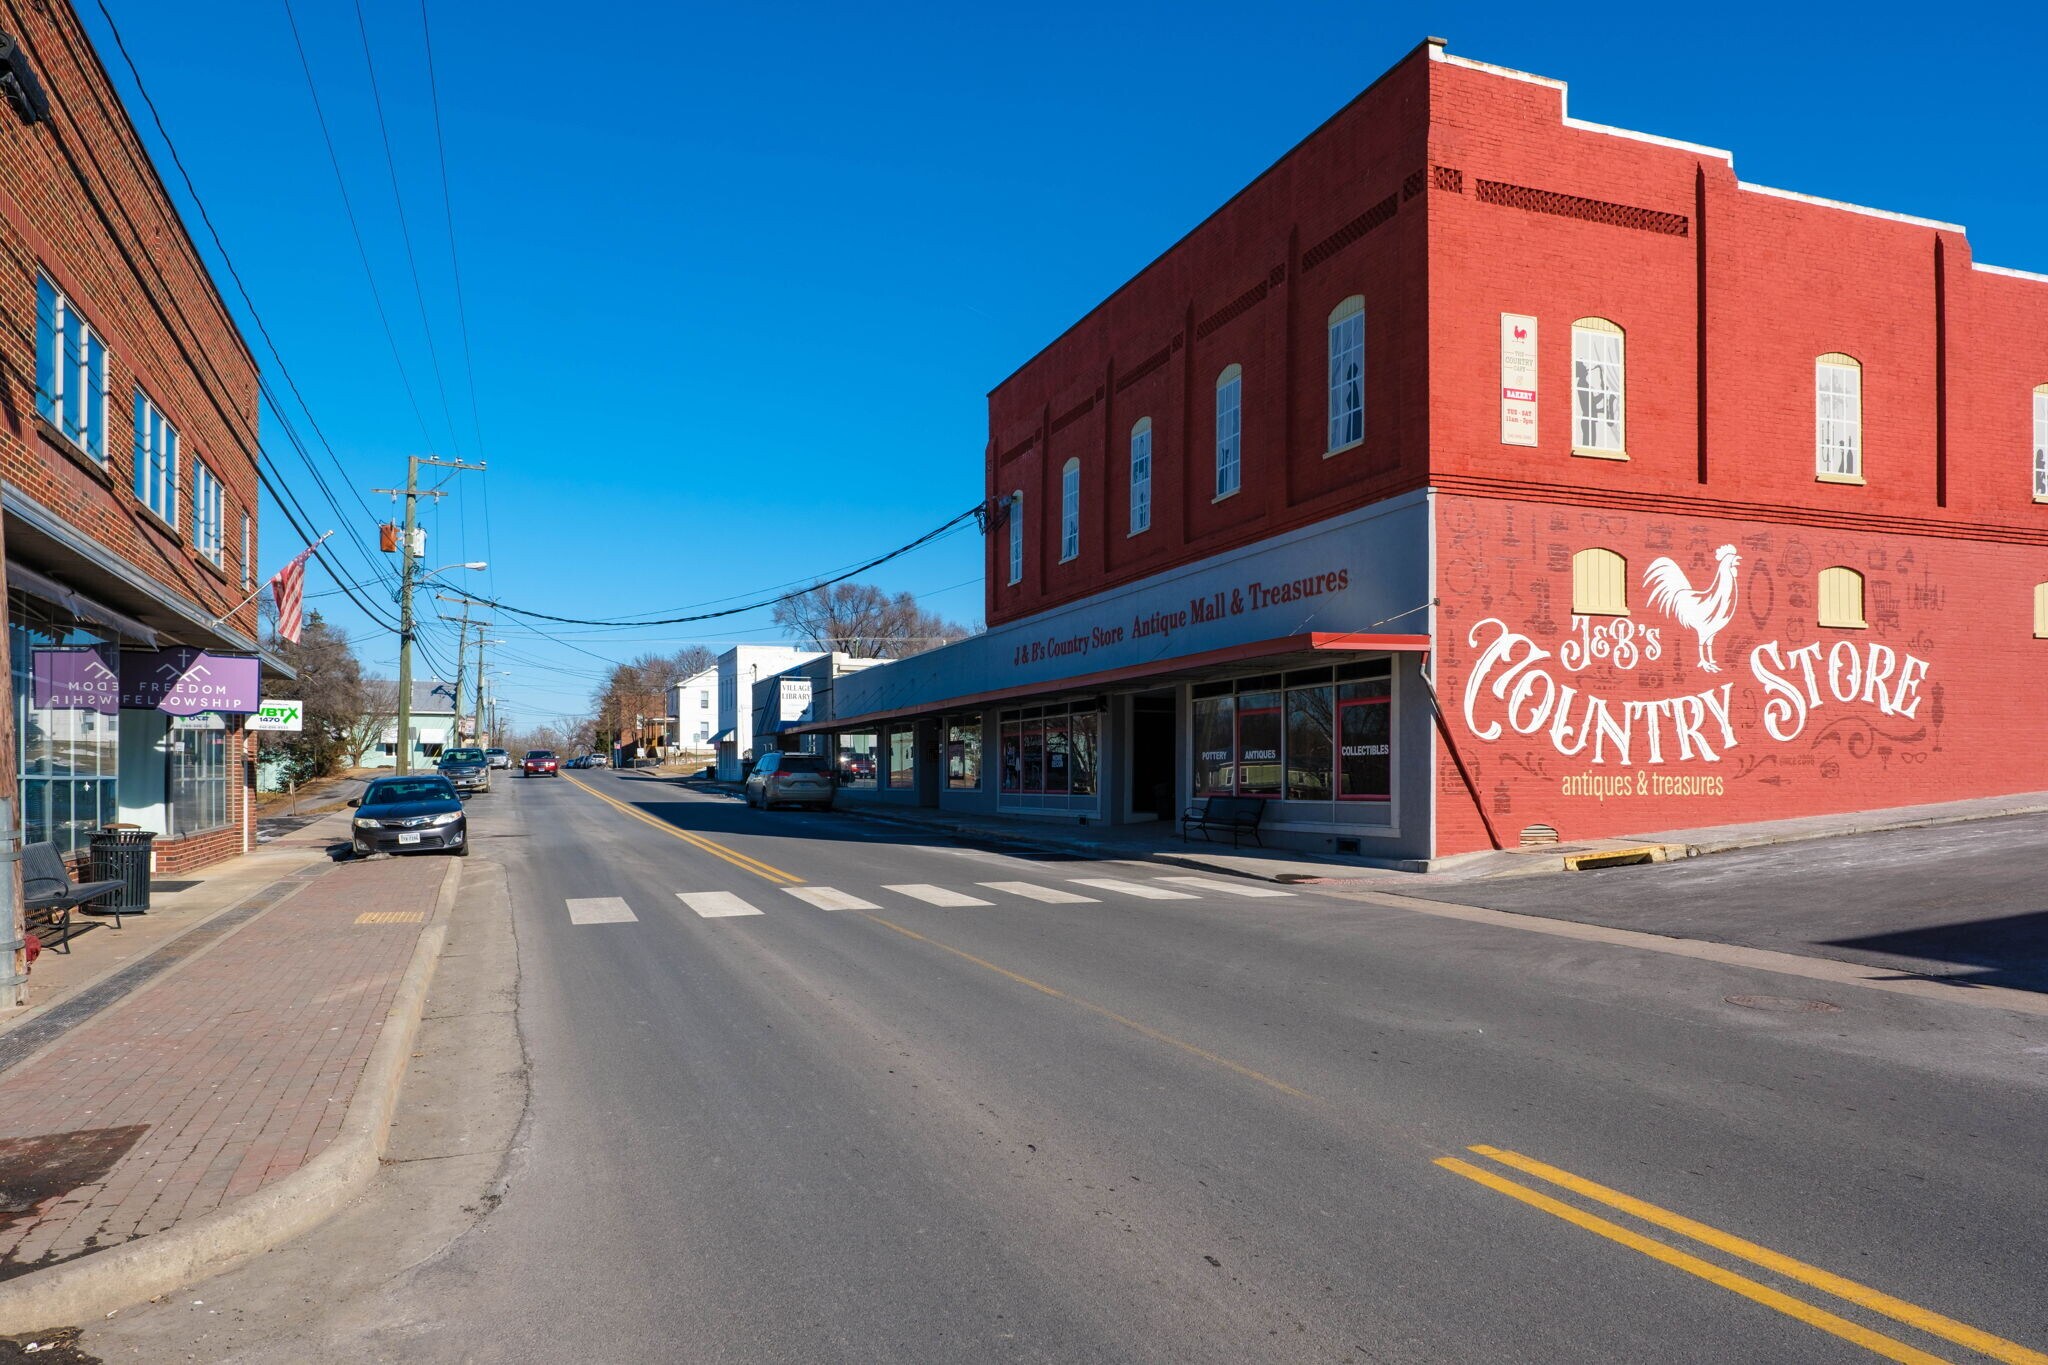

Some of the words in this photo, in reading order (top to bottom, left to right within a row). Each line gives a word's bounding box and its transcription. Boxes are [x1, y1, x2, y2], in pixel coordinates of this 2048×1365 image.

[1505, 356, 1533, 367] COUNTRY
[1014, 647, 1021, 666] J
[1021, 645, 1030, 661] &
[1031, 642, 1046, 661] B's
[1047, 636, 1090, 658] Country
[1092, 627, 1124, 647] Store
[1132, 615, 1187, 639] Antique
[1190, 592, 1226, 625] Mall
[1230, 588, 1244, 615] &
[1249, 568, 1349, 611] Treasures
[139, 682, 227, 695] FREEDOM
[1463, 617, 1738, 765] COUNTRY
[1750, 639, 1930, 742] STORE
[123, 694, 242, 709] FELLOWSHIP
[1202, 751, 1227, 760] POTTERY
[1244, 750, 1276, 759] ANTIQUES
[1342, 744, 1389, 756] COLLECTIBLES
[1562, 771, 1633, 801] antiques
[1637, 770, 1649, 796] &
[1651, 773, 1724, 796] treasures
